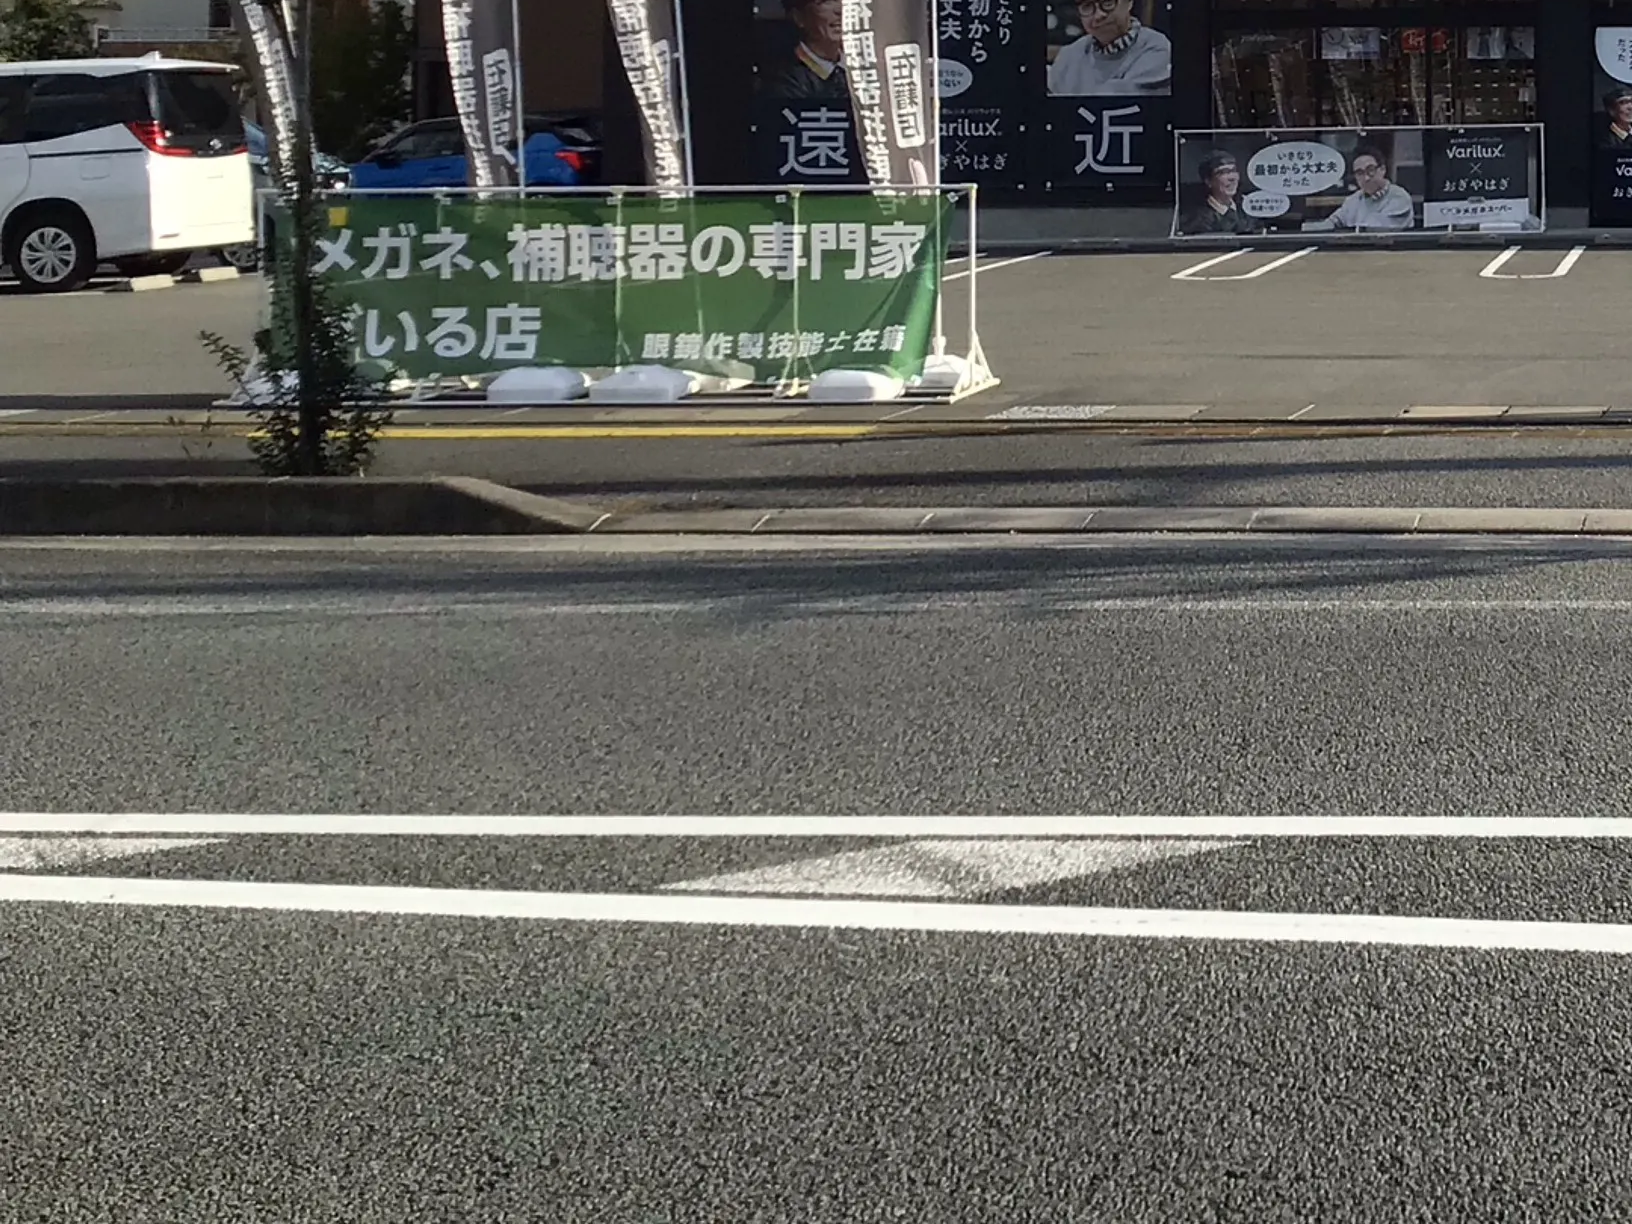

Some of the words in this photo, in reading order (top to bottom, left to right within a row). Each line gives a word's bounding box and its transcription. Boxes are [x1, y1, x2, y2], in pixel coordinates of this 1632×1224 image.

[779, 105, 851, 176] 遠
[938, 118, 1000, 137] arilux
[1073, 104, 1145, 176] 近
[1255, 161, 1338, 176] 最初から大丈夫
[1446, 144, 1503, 159] Varilux
[1442, 177, 1510, 192] おぎやはぎ
[311, 222, 927, 282] メガネ、補聴器の専門家
[342, 302, 543, 360] いる店
